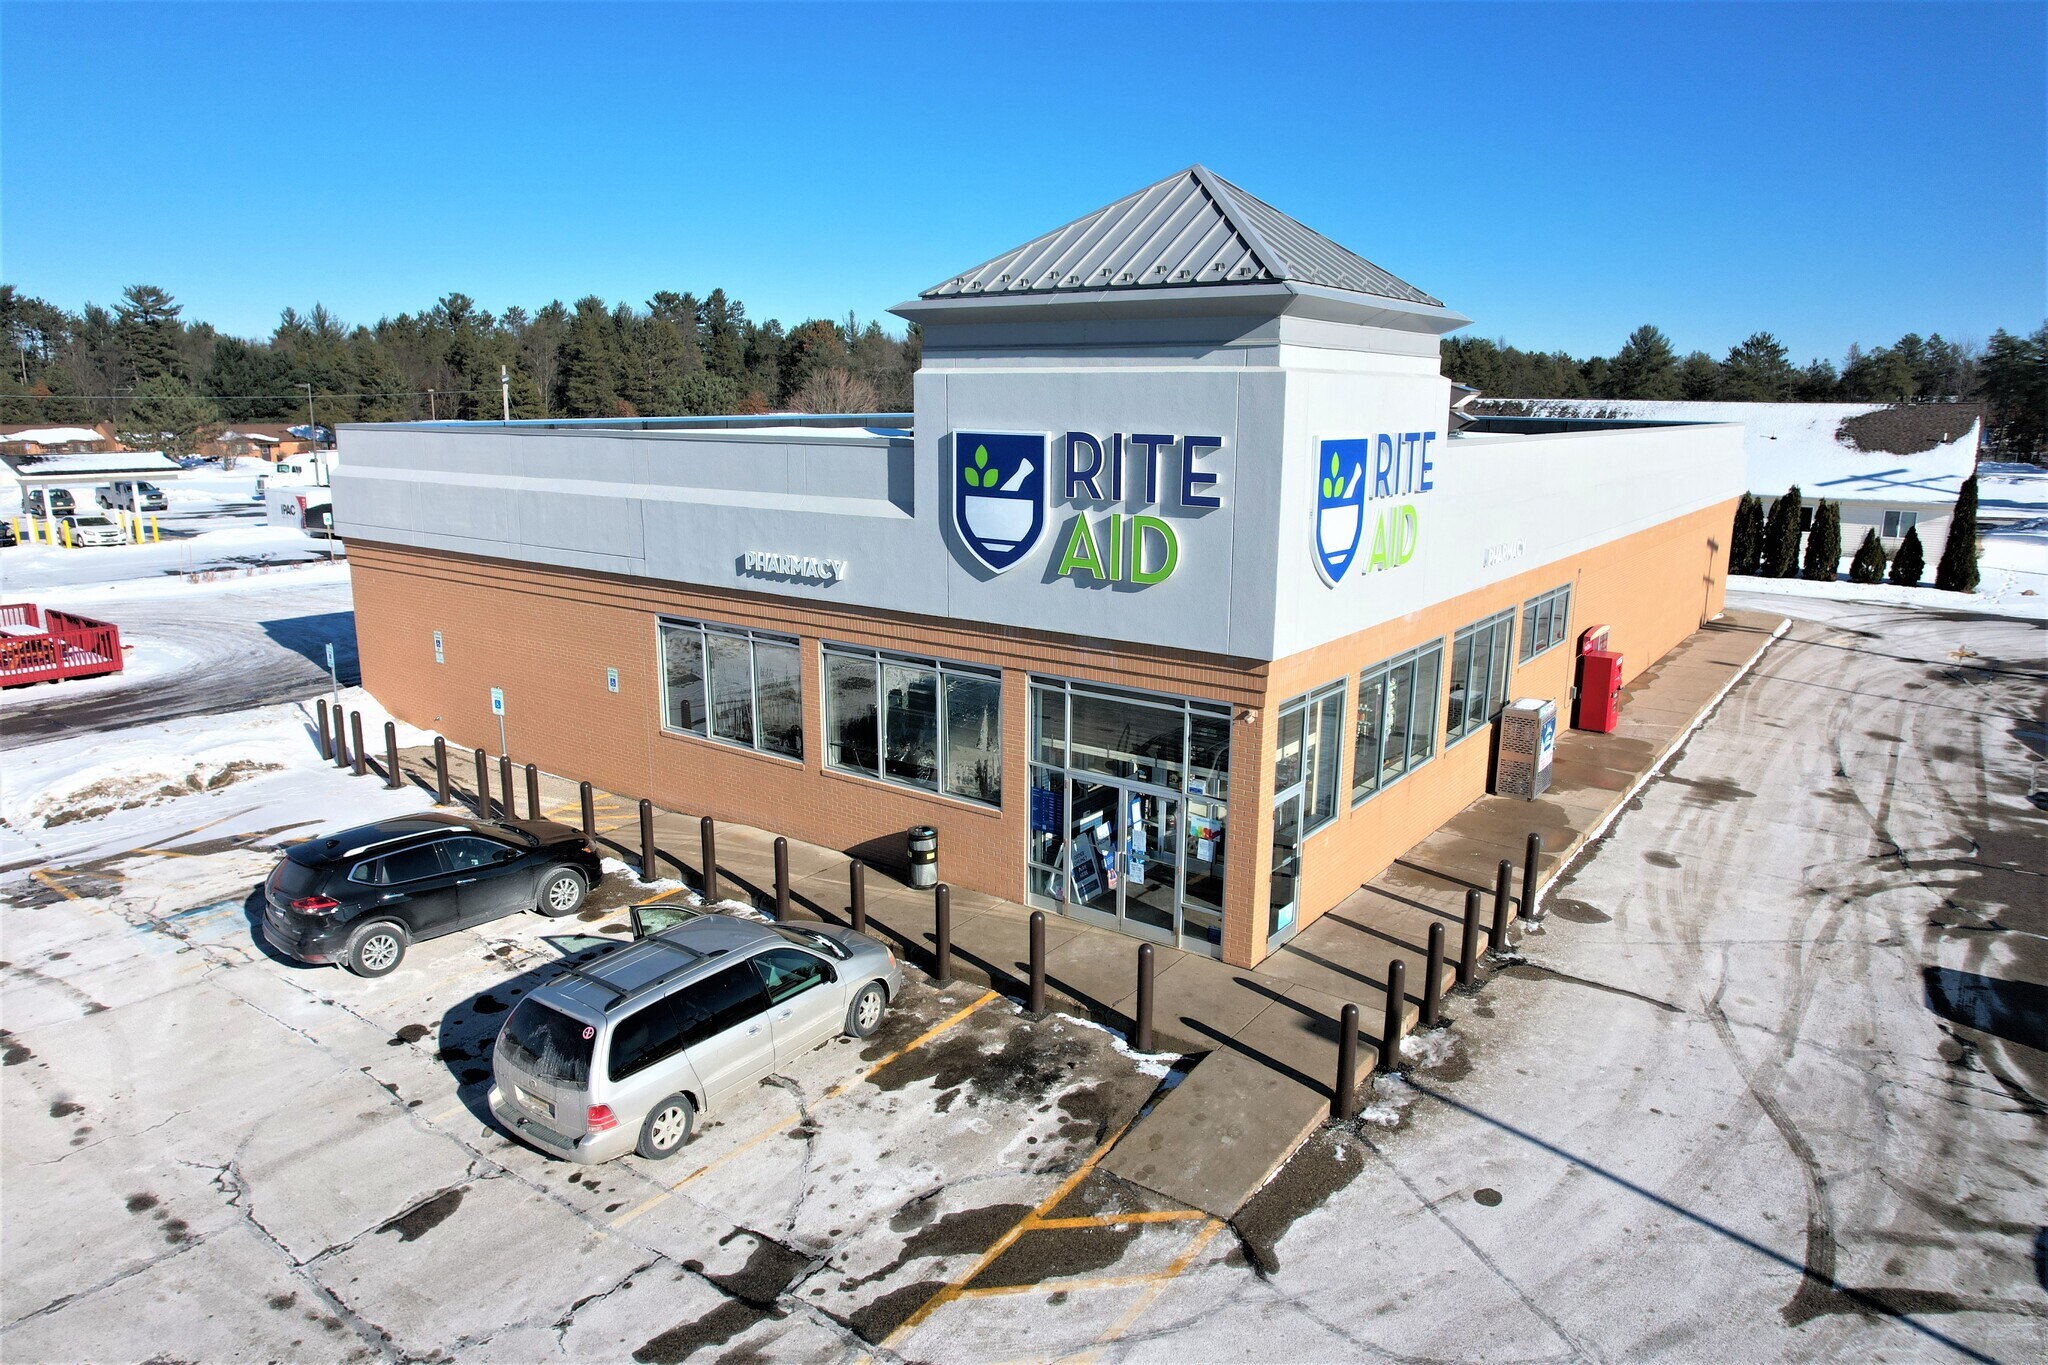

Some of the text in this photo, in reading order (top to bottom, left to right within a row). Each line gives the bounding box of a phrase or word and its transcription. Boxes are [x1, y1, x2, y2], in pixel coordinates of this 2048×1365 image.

[1065, 431, 1224, 507] RITE
[1371, 431, 1436, 499] RITE
[744, 551, 848, 580] PHARMACY
[1058, 511, 1181, 585] AID
[1364, 504, 1418, 574] AID
[1485, 537, 1528, 567] PHARMACY
